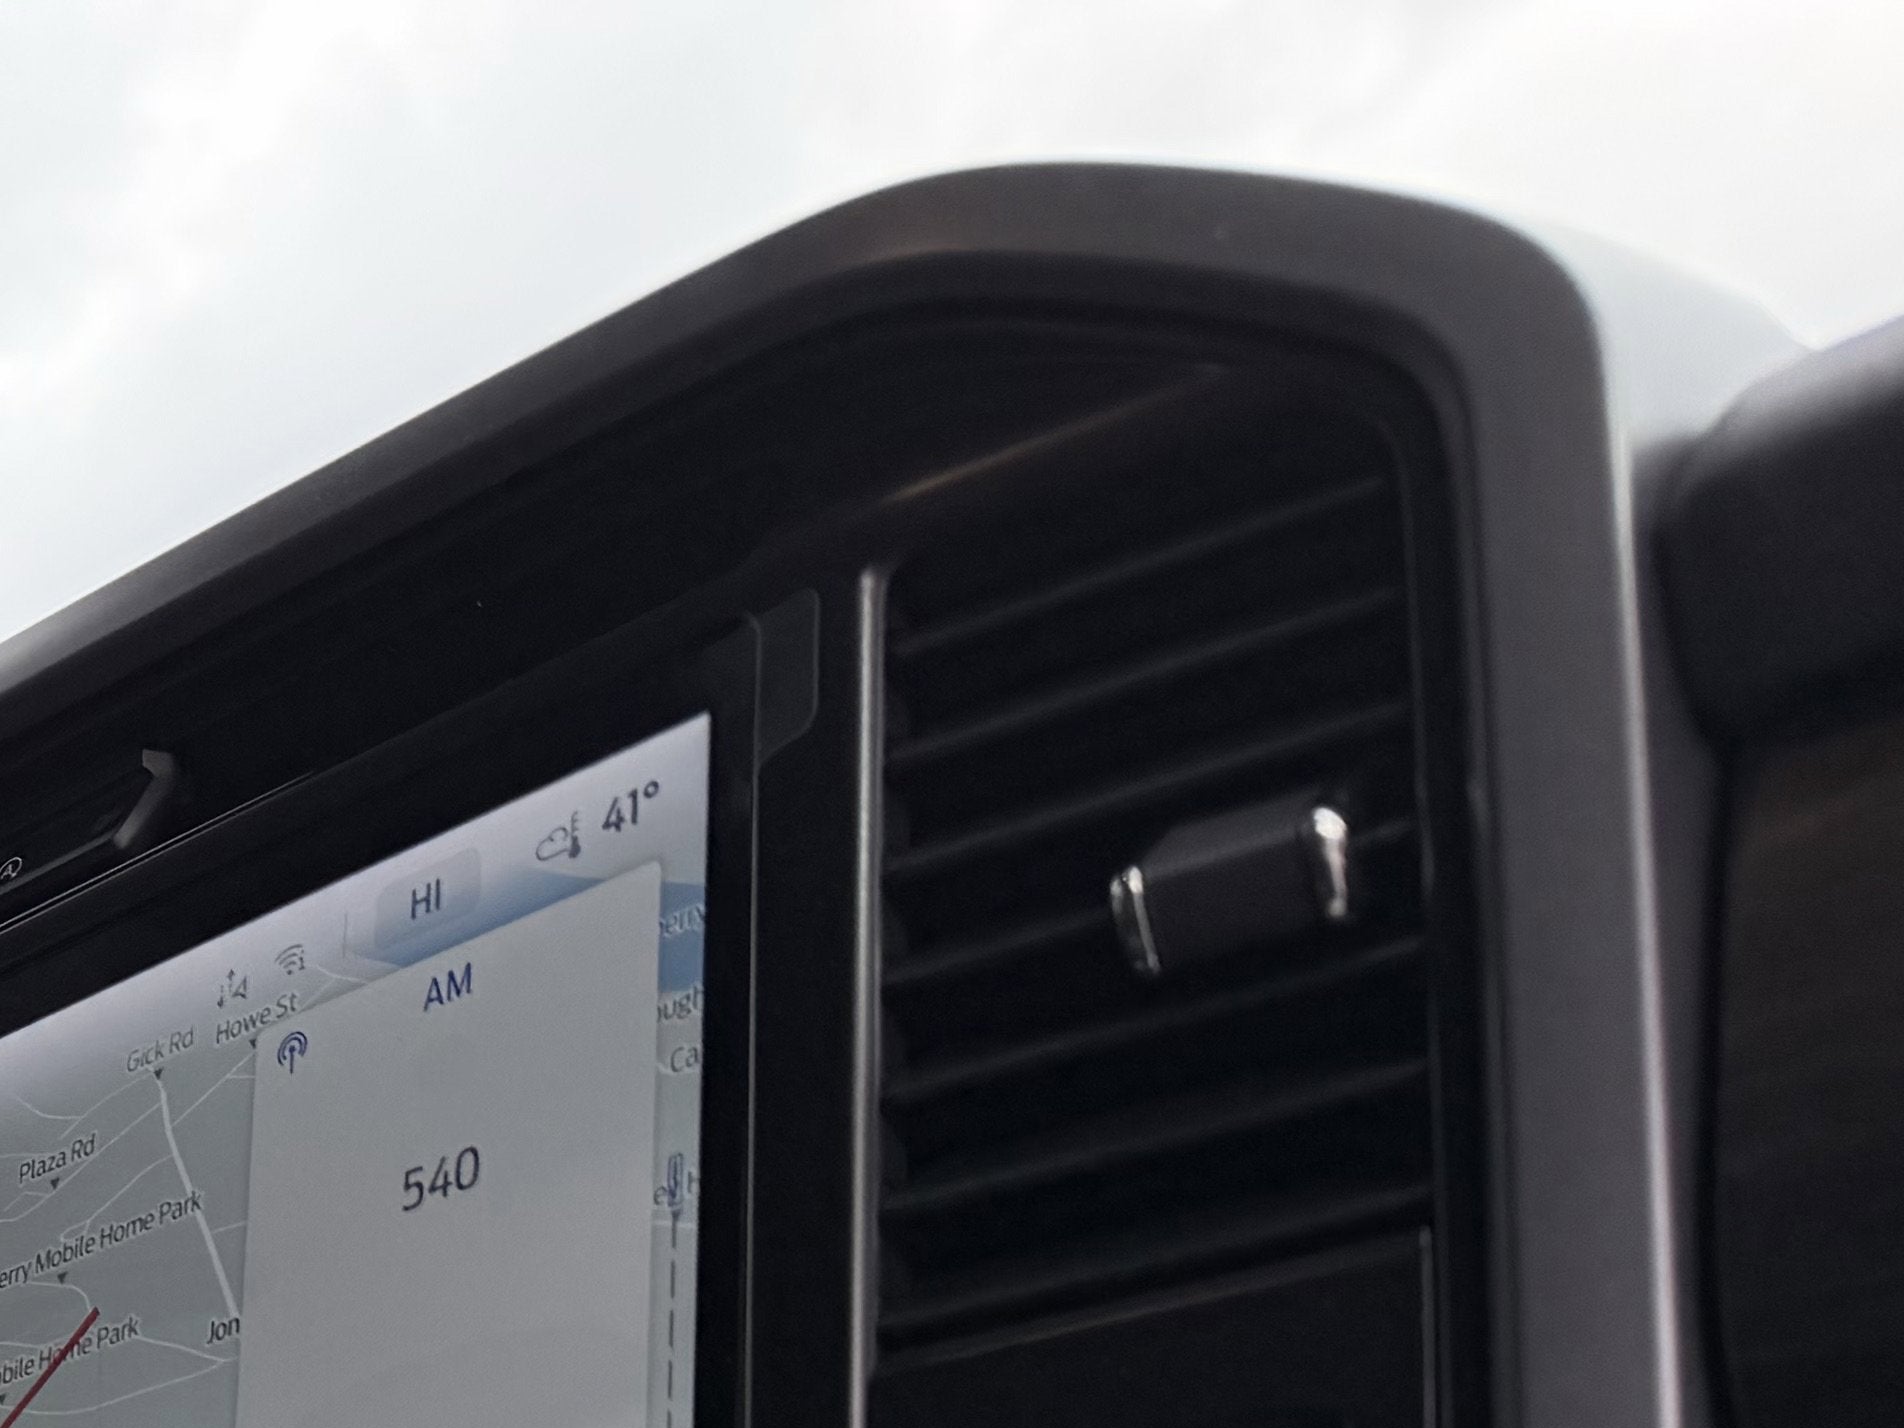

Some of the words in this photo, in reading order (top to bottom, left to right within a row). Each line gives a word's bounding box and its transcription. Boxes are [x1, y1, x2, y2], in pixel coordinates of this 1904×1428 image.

[602, 780, 661, 832] 41°
[410, 878, 442, 920] HI
[424, 963, 473, 1011] AM
[168, 1027, 194, 1059] Rd
[215, 1005, 272, 1046] Howe
[276, 993, 297, 1025] St
[18, 1147, 67, 1185] Plaza
[70, 1133, 97, 1164] Rd
[402, 1147, 480, 1212] 540
[34, 1228, 96, 1276] Mobile
[99, 1210, 155, 1248] Home
[158, 1191, 203, 1227] Park
[96, 1317, 141, 1348] Park
